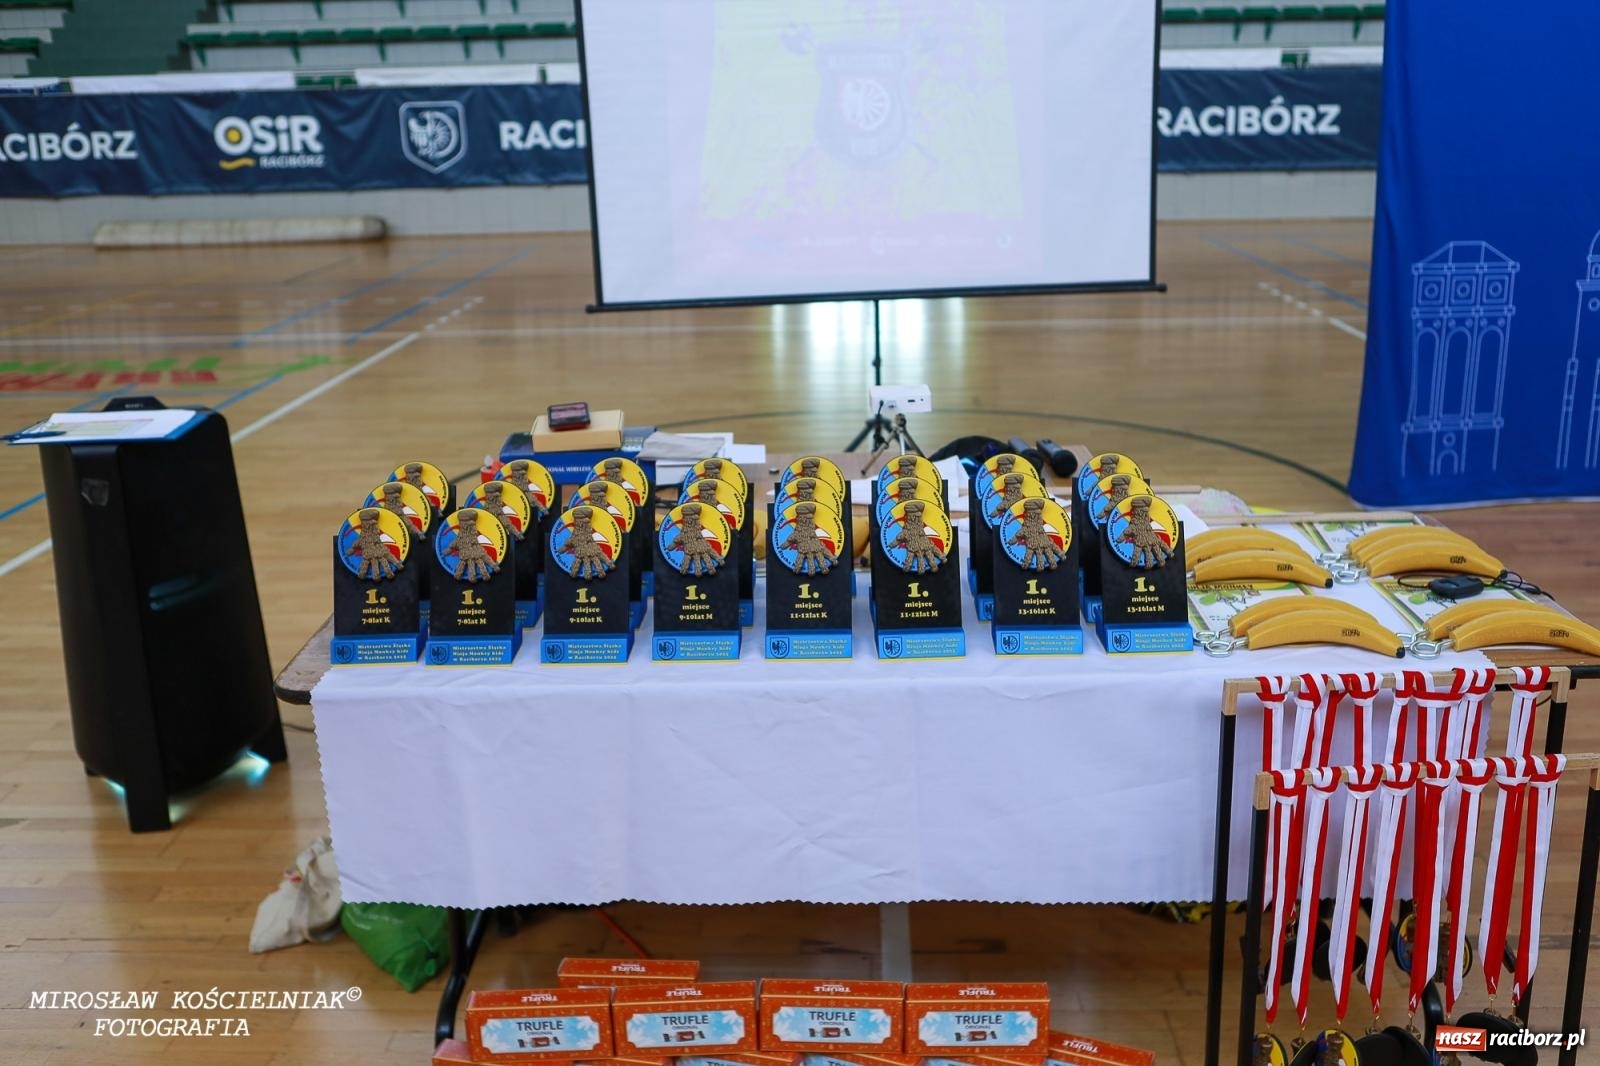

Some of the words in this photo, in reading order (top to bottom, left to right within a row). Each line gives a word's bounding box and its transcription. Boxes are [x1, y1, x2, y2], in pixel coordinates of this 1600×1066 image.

[1157, 95, 1341, 136] RACIBÓRZ
[0, 121, 139, 162] CIBÓRZ
[213, 115, 325, 156] OSiR
[798, 583, 820, 599] 1.
[907, 582, 929, 598] 1.
[1026, 579, 1048, 594] 1.
[1134, 577, 1156, 592] 1.
[366, 588, 386, 604] 1.
[462, 589, 483, 604] 1.
[576, 588, 597, 603] 1.
[685, 585, 707, 600] 1.
[1131, 595, 1159, 603] miejsce
[572, 606, 600, 614] miejsce
[384, 616, 391, 624] K
[661, 1014, 709, 1026] TRUFLE
[808, 1011, 856, 1022] TRUFLE
[955, 1014, 1003, 1025] TRUFLE
[516, 1020, 563, 1031] TRUFLE
